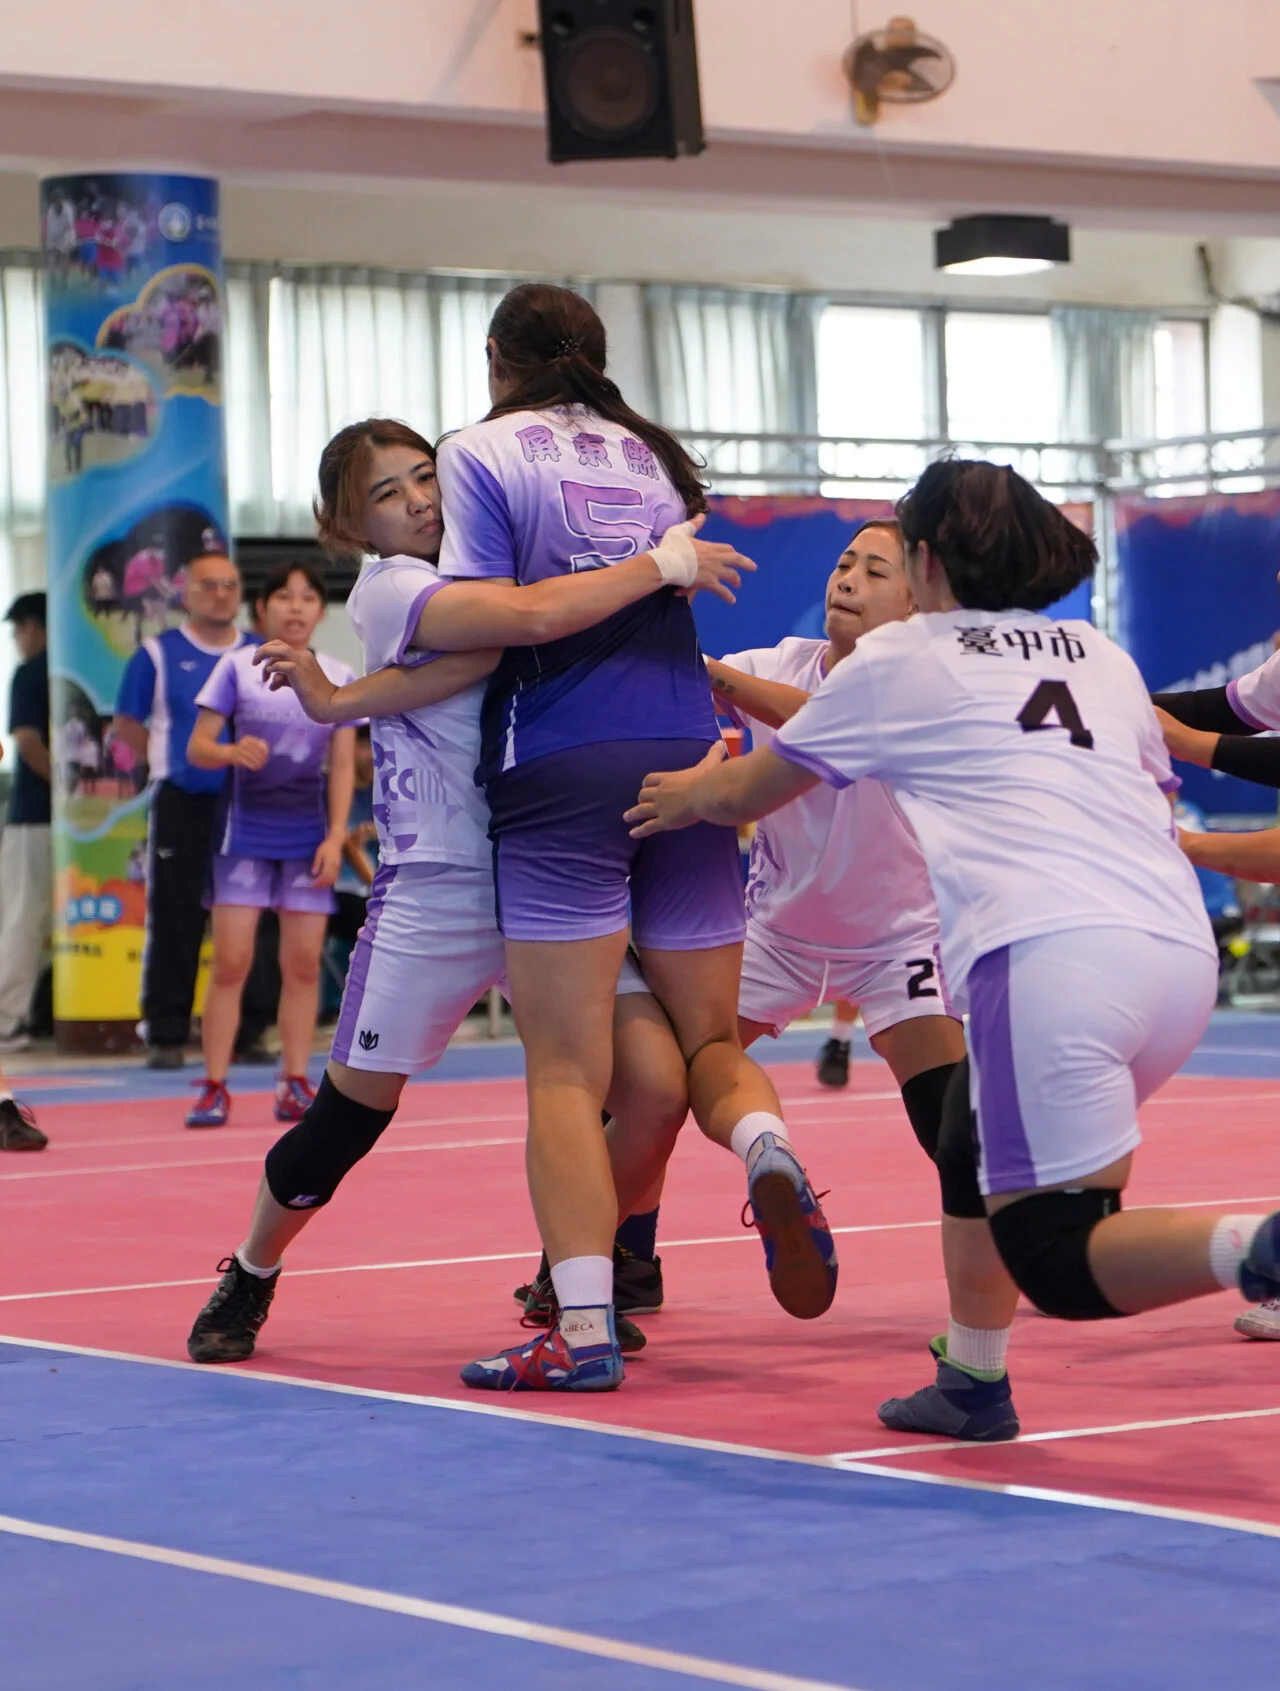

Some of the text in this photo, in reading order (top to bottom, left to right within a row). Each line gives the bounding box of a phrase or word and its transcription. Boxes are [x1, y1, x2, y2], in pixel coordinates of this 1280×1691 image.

[560, 479, 657, 574] 5
[953, 625, 1086, 663] 臺中市
[1014, 679, 1095, 750] 4
[905, 958, 938, 1000] 2
